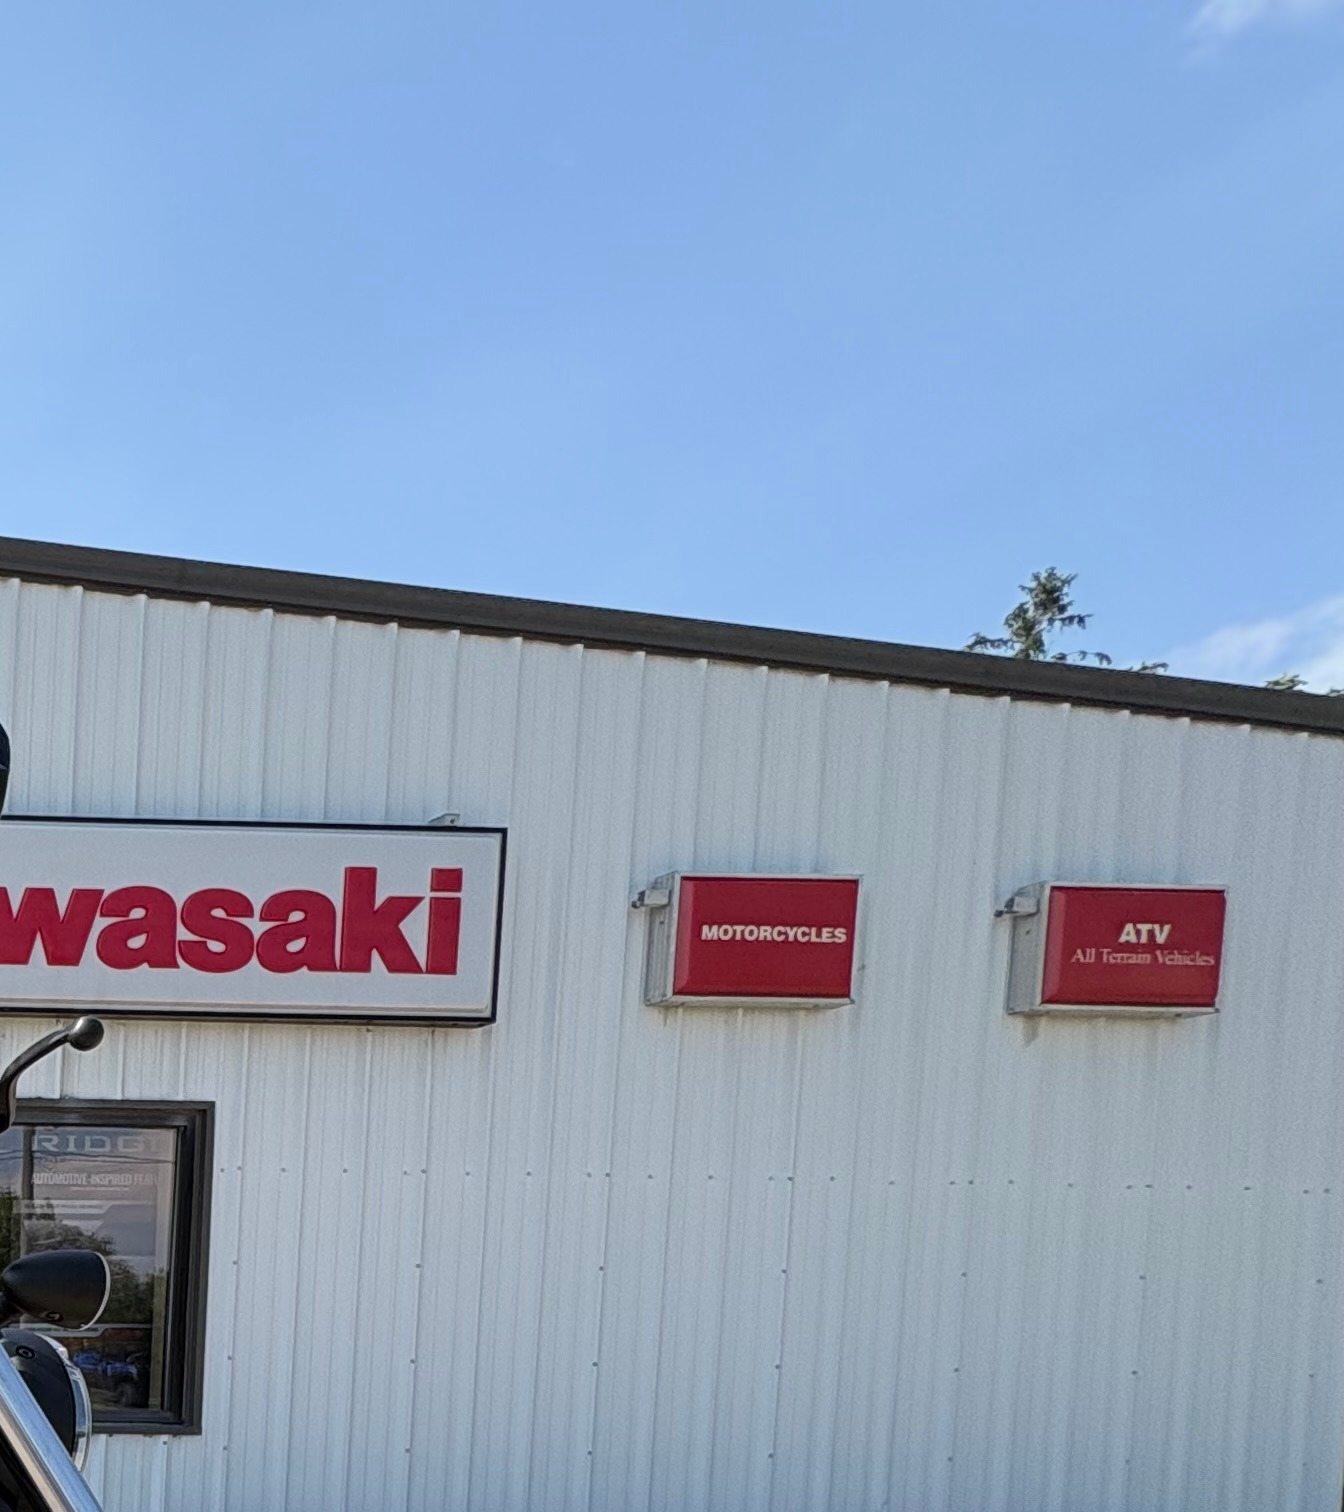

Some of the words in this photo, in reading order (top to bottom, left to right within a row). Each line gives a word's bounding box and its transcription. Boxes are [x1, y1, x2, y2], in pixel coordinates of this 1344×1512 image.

[700, 924, 848, 945] MOTORCYCLES
[1117, 922, 1172, 945] ATV
[1071, 948, 1096, 964] All
[1099, 948, 1151, 965] Terrain
[1155, 949, 1216, 966] Vehicles
